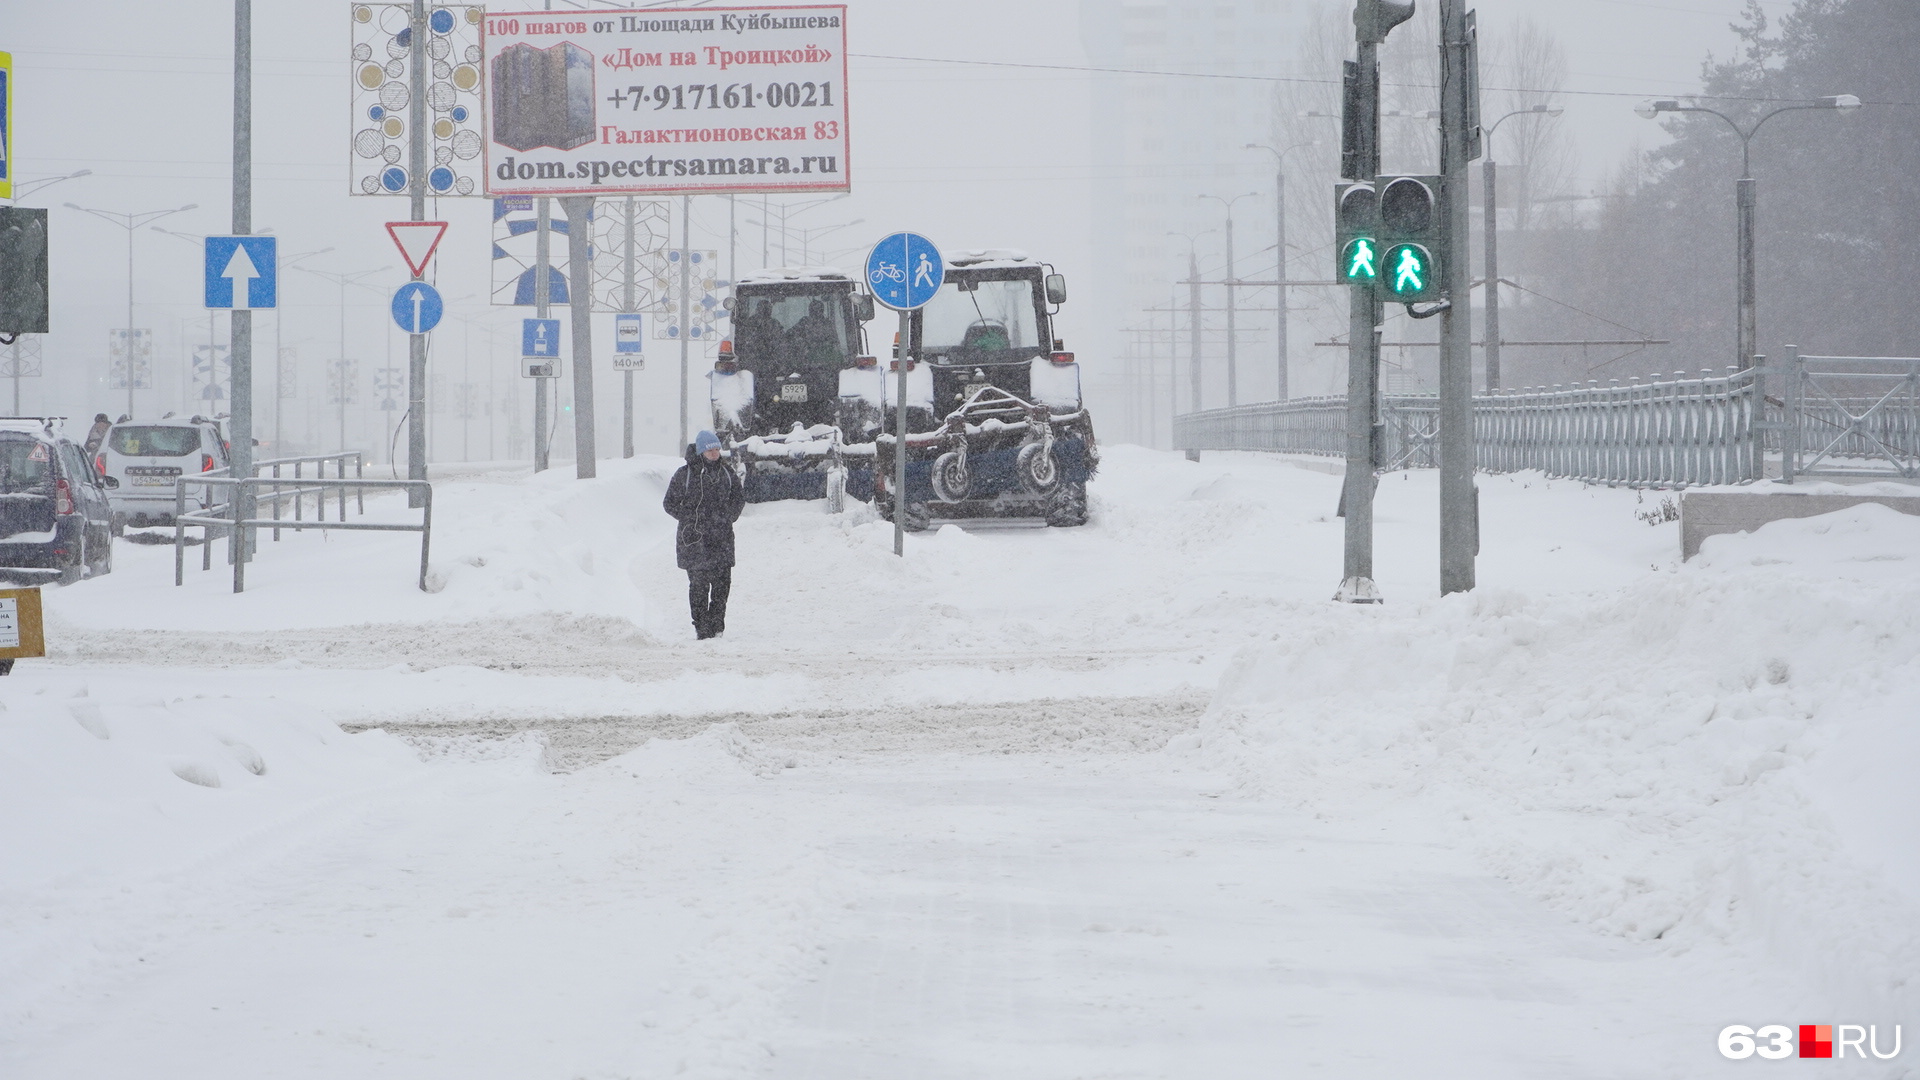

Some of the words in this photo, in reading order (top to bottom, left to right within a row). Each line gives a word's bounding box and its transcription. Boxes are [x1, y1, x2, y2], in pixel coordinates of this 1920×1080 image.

[487, 19, 520, 36] 100
[525, 21, 588, 36] шагов
[593, 21, 615, 34] от
[619, 16, 715, 34] Площади
[720, 12, 841, 35] Куйбышева
[601, 48, 662, 72] «Дом
[669, 51, 697, 66] на
[703, 44, 833, 71] Троицкой»
[600, 125, 807, 145] Галактионовская
[813, 120, 840, 141] 83
[496, 154, 838, 184] dom.spectrsamara.ru
[617, 358, 632, 367] 40
[784, 385, 805, 394] 5929
